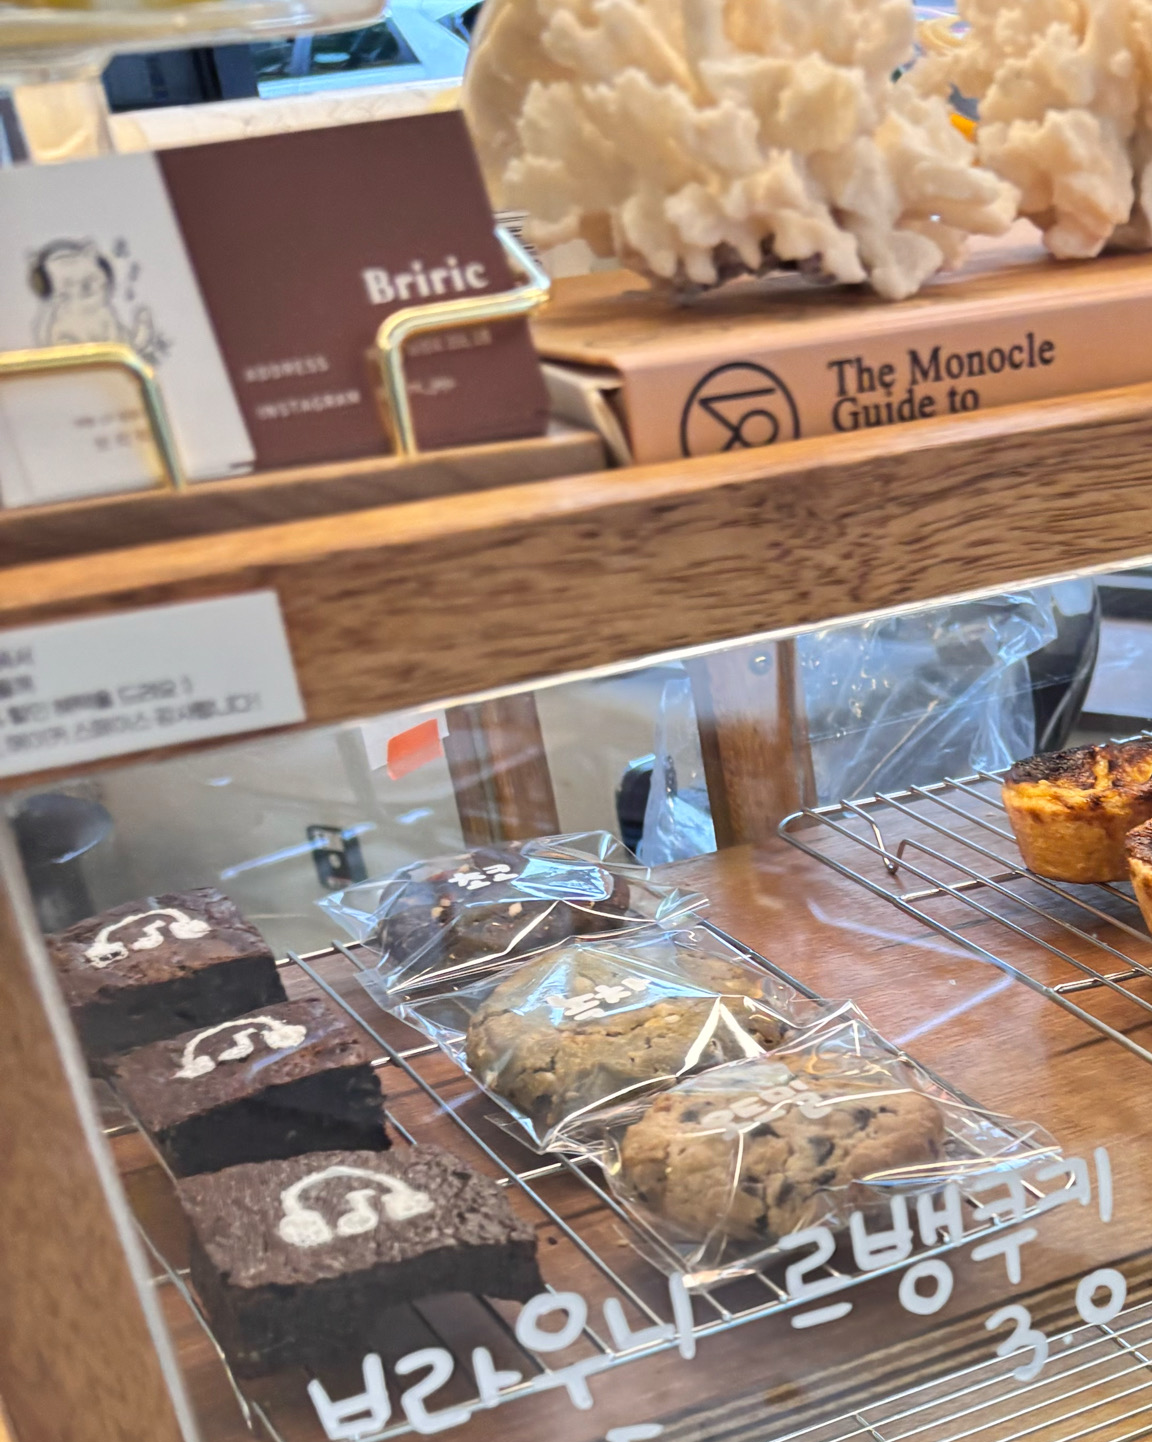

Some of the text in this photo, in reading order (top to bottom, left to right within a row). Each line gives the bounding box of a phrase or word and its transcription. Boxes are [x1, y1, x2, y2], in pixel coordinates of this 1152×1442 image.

[362, 256, 488, 305] Briric
[828, 332, 1056, 398] The Monocle
[832, 385, 980, 432] Guide to
[778, 1146, 1113, 1329] 르뱅쿠키
[984, 1267, 1127, 1382] 3.0
